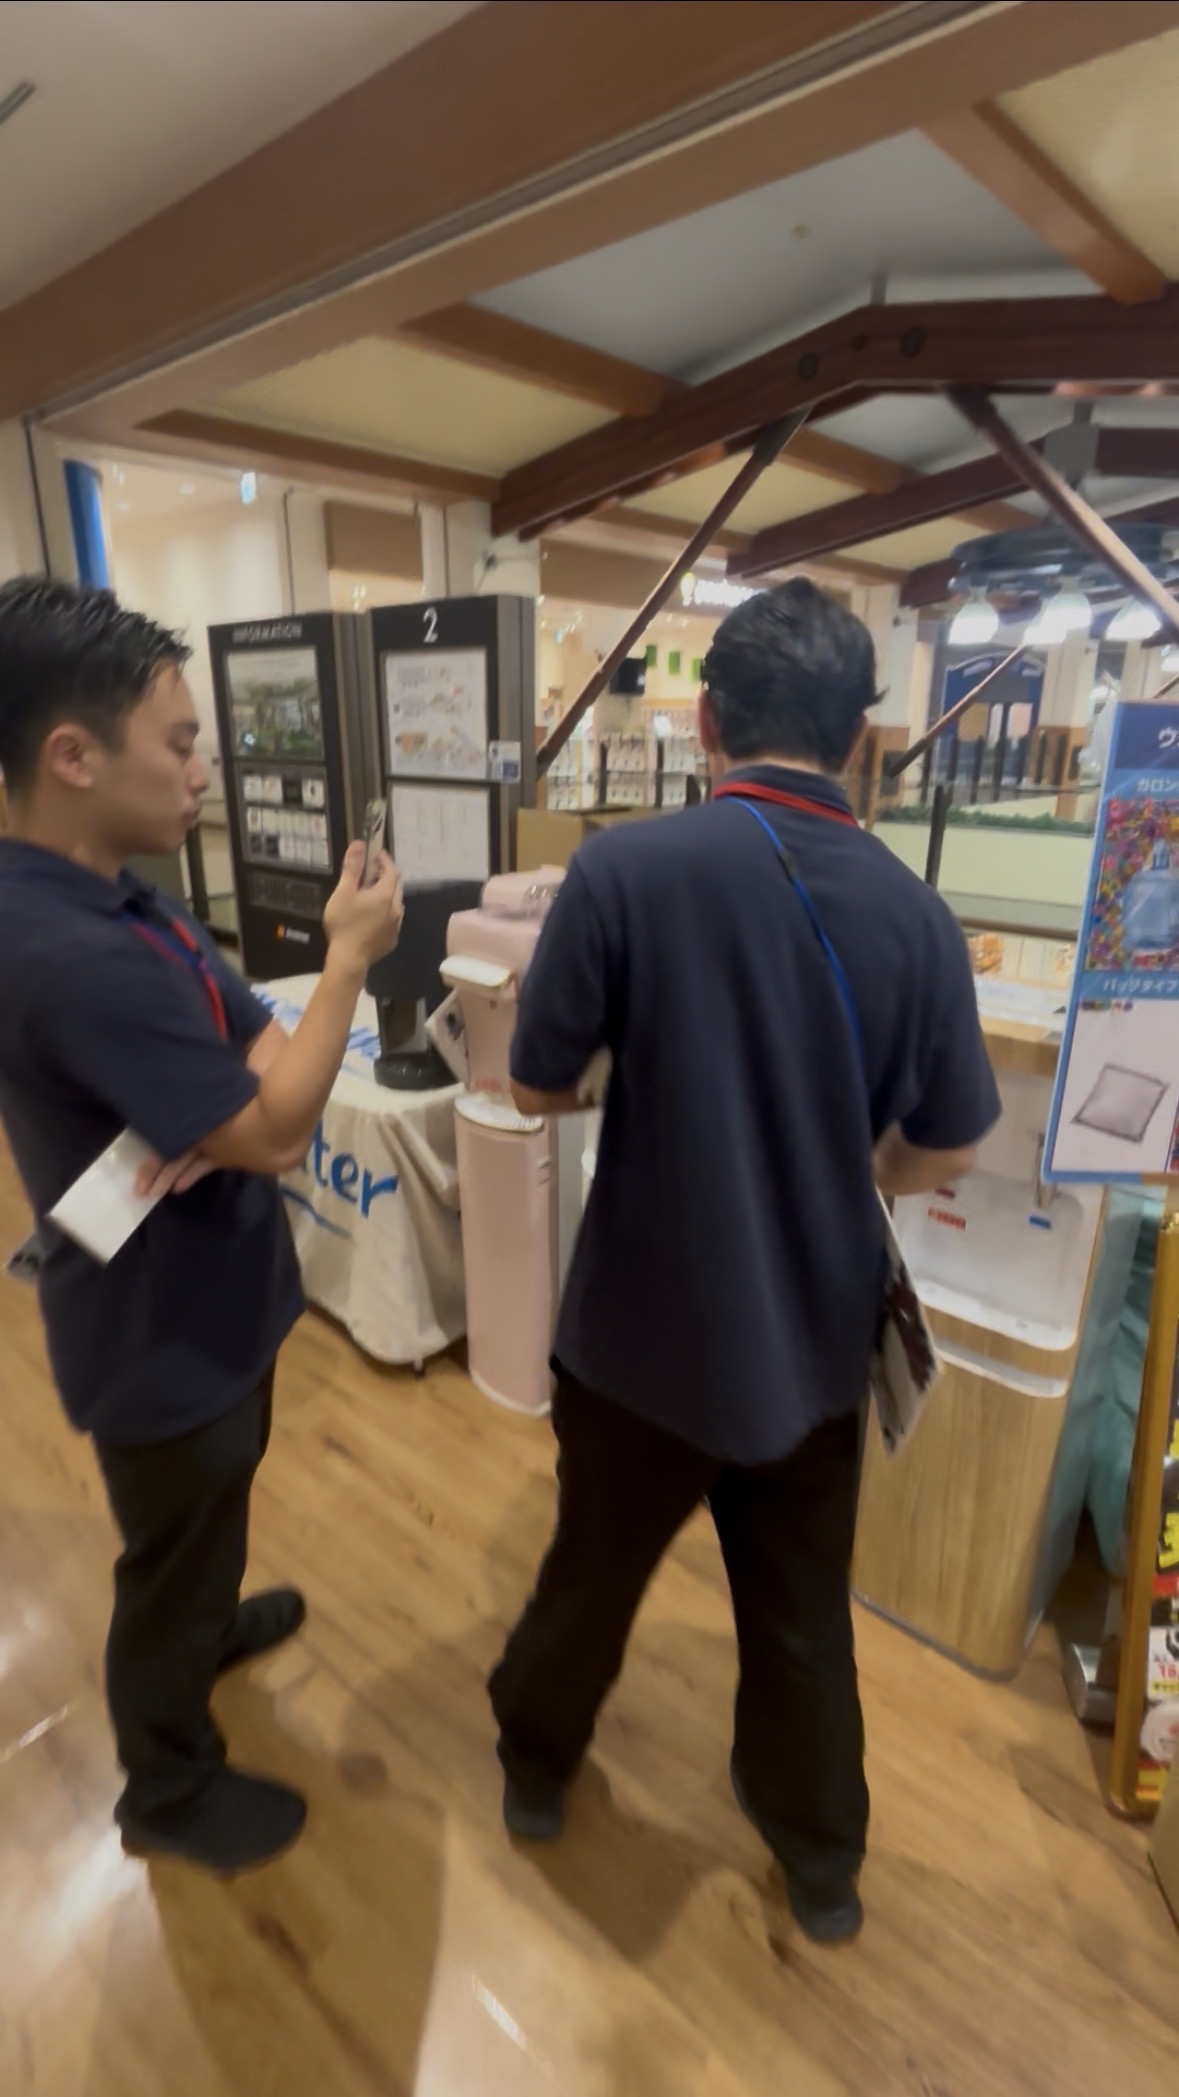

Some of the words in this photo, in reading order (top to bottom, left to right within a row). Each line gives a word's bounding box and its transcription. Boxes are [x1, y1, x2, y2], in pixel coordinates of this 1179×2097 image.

[233, 622, 302, 643] INFORMATION
[423, 607, 438, 643] 2
[1158, 727, 1179, 748] ウ
[1137, 777, 1179, 792] ガロン
